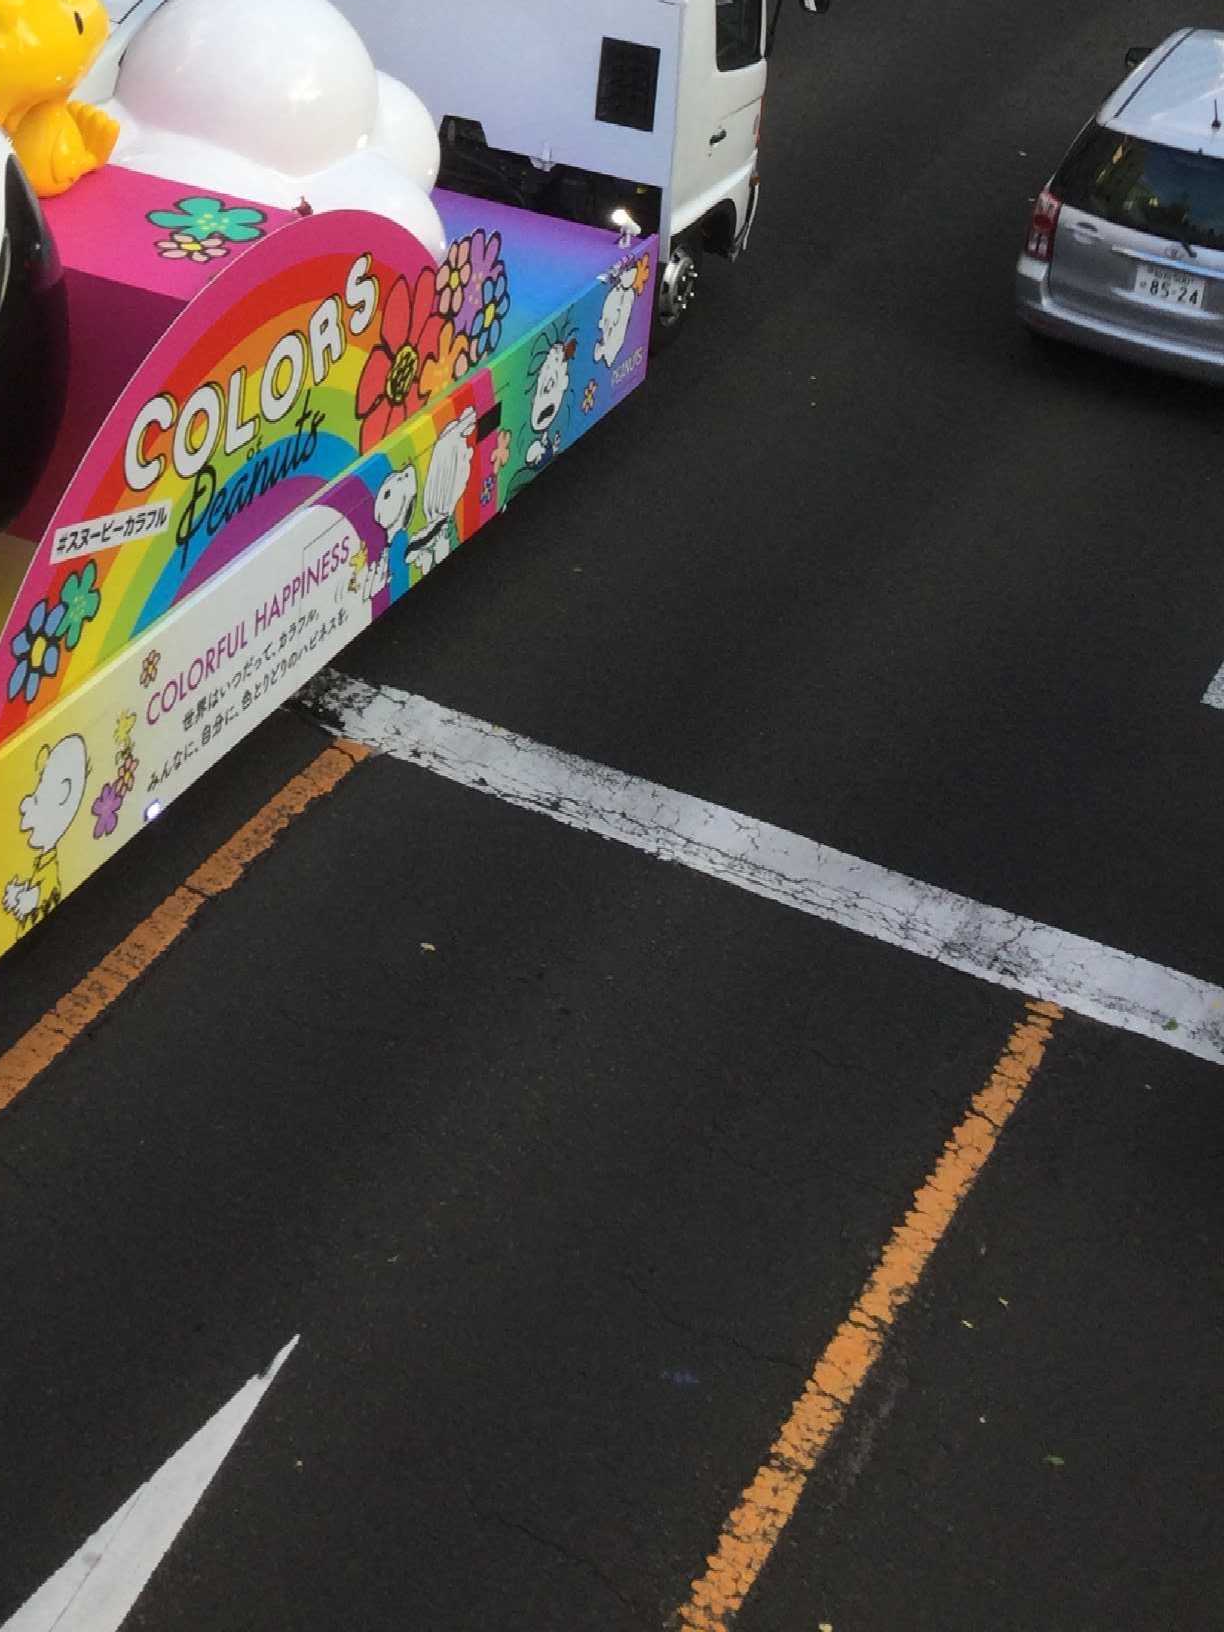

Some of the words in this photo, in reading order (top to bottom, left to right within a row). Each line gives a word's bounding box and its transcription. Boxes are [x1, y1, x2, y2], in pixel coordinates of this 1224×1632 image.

[123, 251, 380, 492] COLORS
[175, 389, 326, 571] Peanuts
[146, 620, 249, 725] COLORFUL
[254, 535, 351, 637] HAPPINESS
